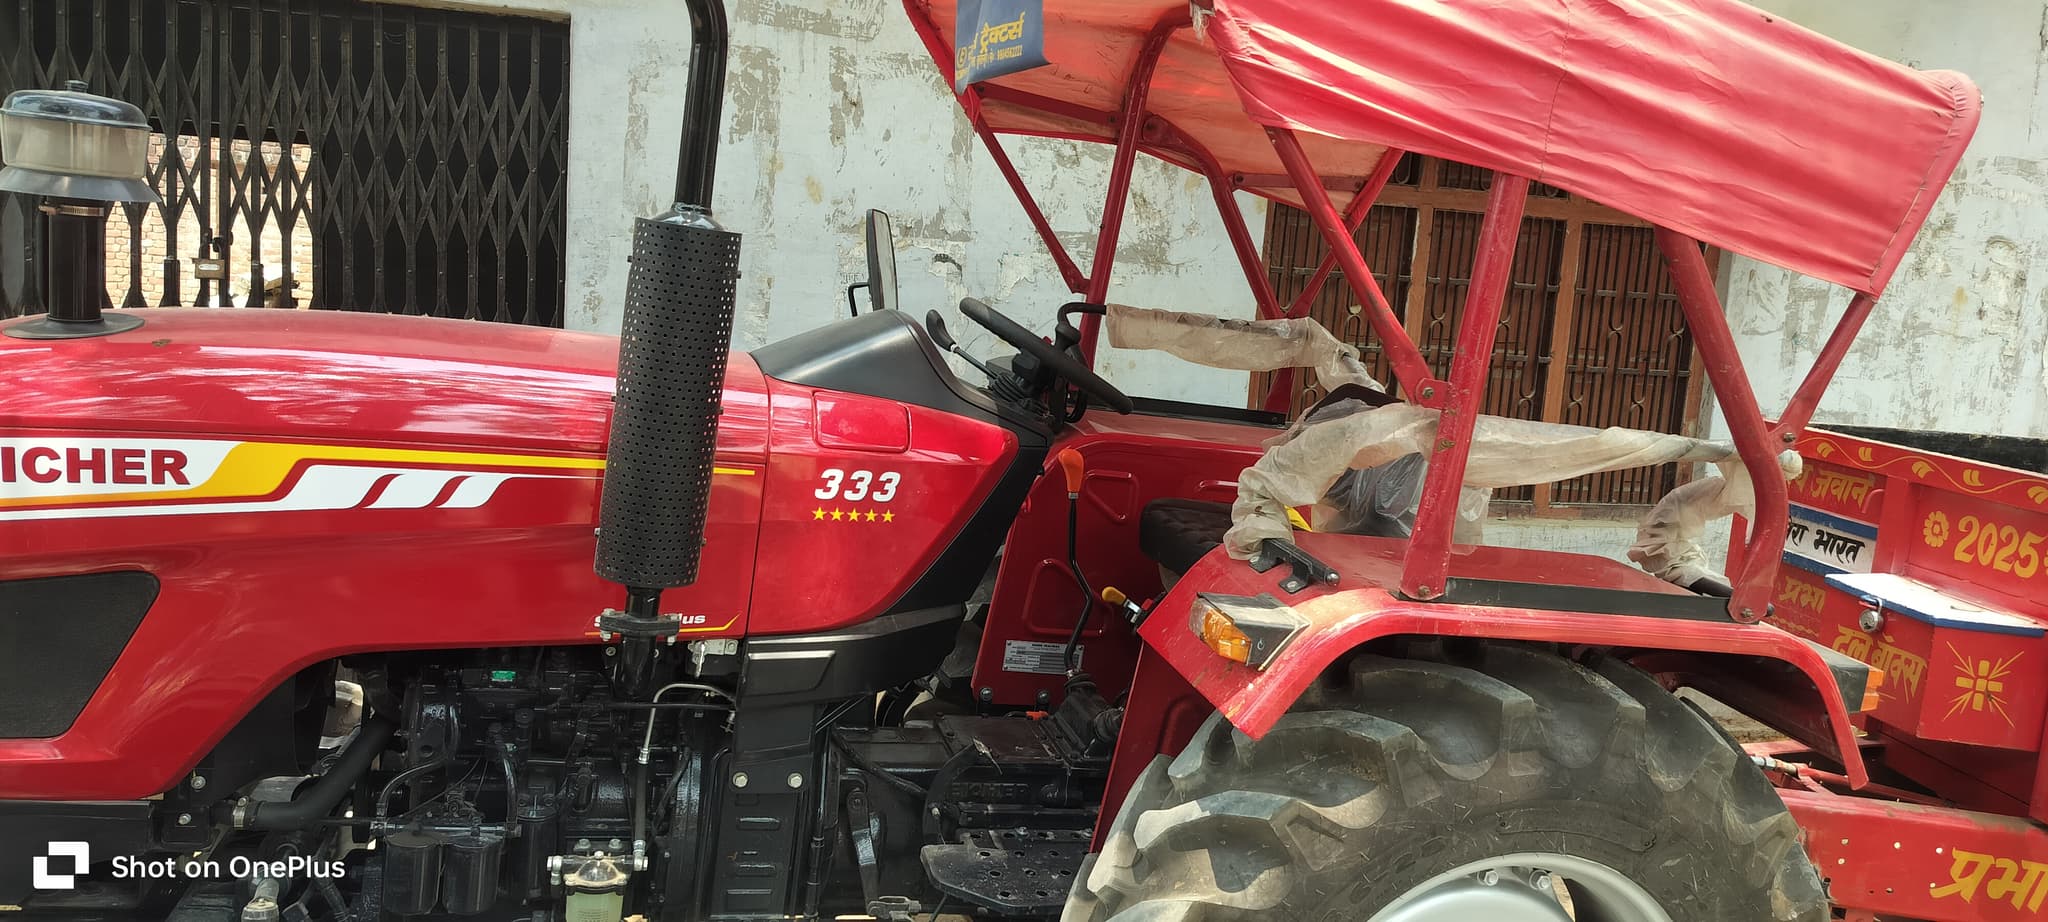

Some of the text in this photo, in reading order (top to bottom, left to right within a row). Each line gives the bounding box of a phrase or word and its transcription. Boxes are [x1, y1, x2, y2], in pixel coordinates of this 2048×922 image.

[814, 468, 901, 502] 333
[1813, 528, 1866, 565] भारत
[1954, 515, 2048, 578] 2025
